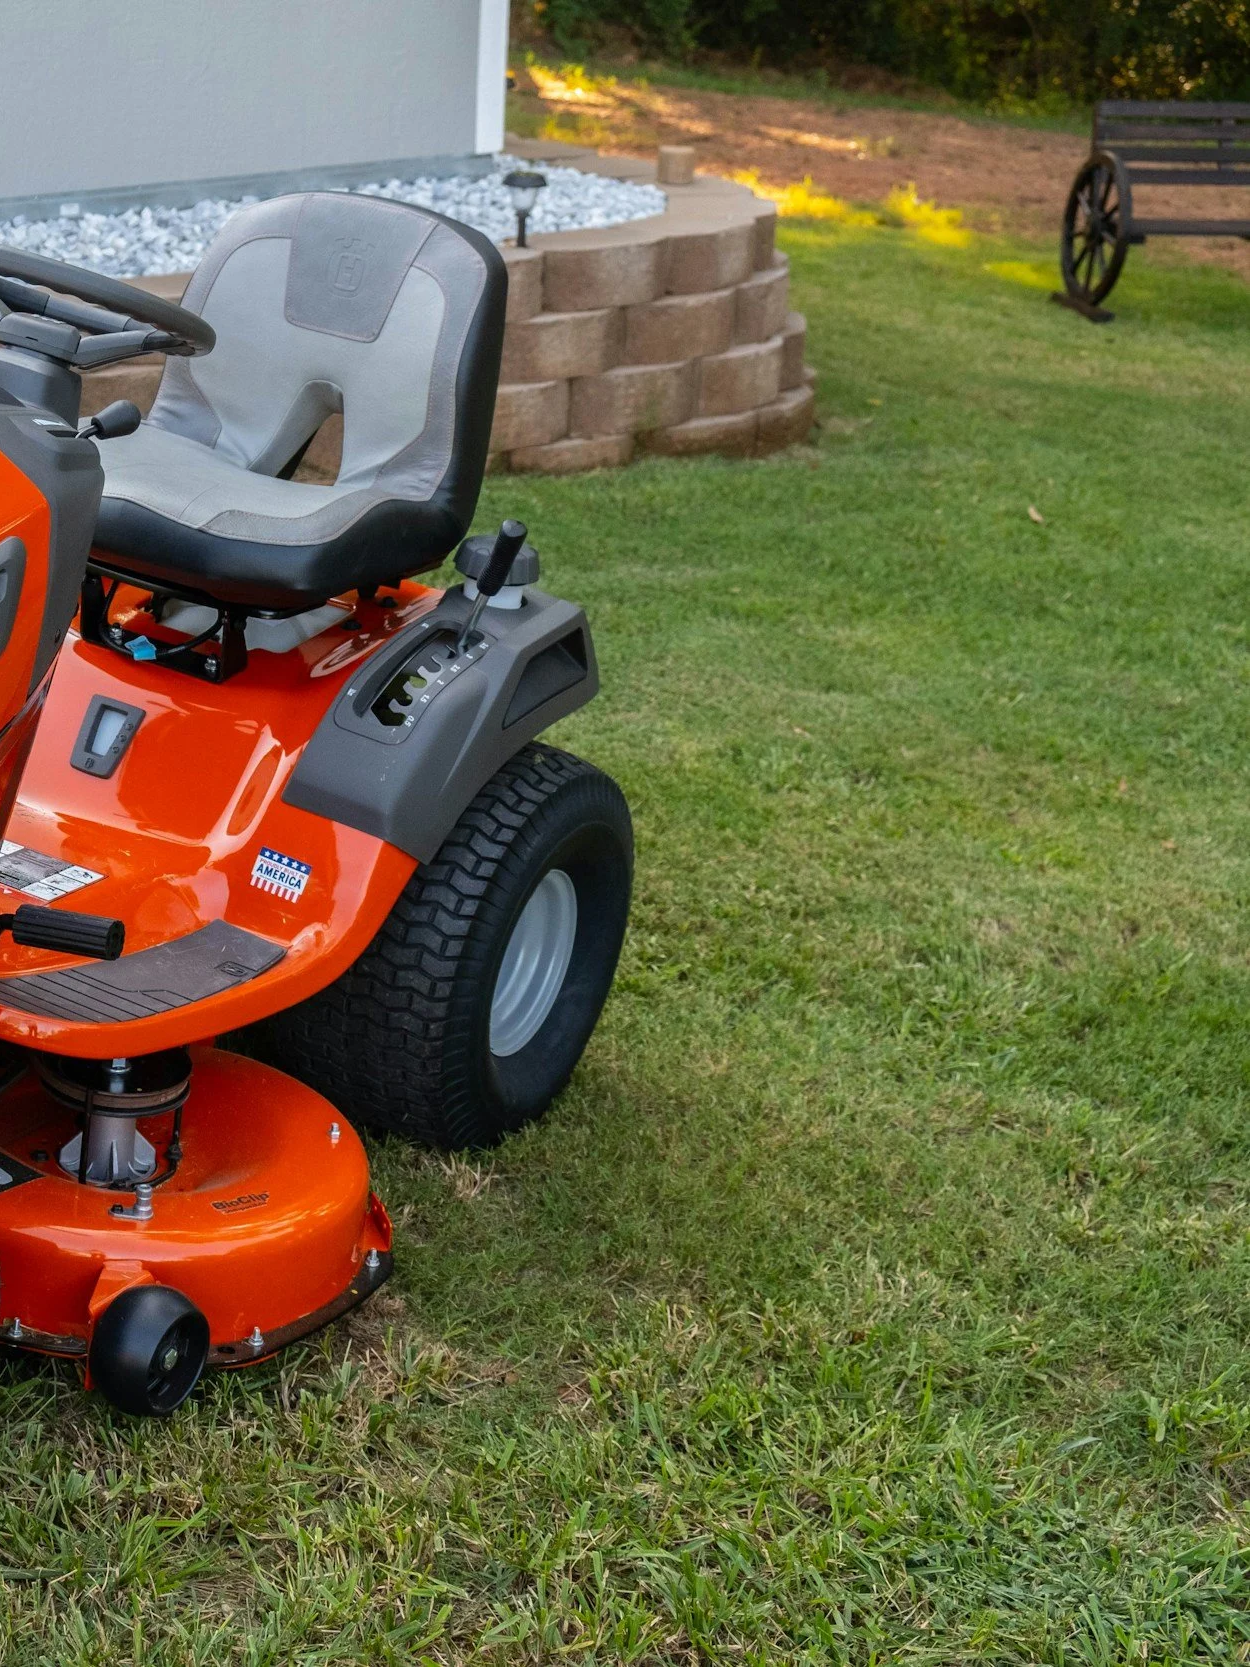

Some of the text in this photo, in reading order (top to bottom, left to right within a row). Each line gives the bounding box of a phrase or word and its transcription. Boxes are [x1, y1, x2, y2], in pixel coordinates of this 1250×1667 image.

[256, 863, 302, 890] AMERICA
[260, 858, 283, 871] PROUDLY
[283, 867, 299, 877] BUILT
